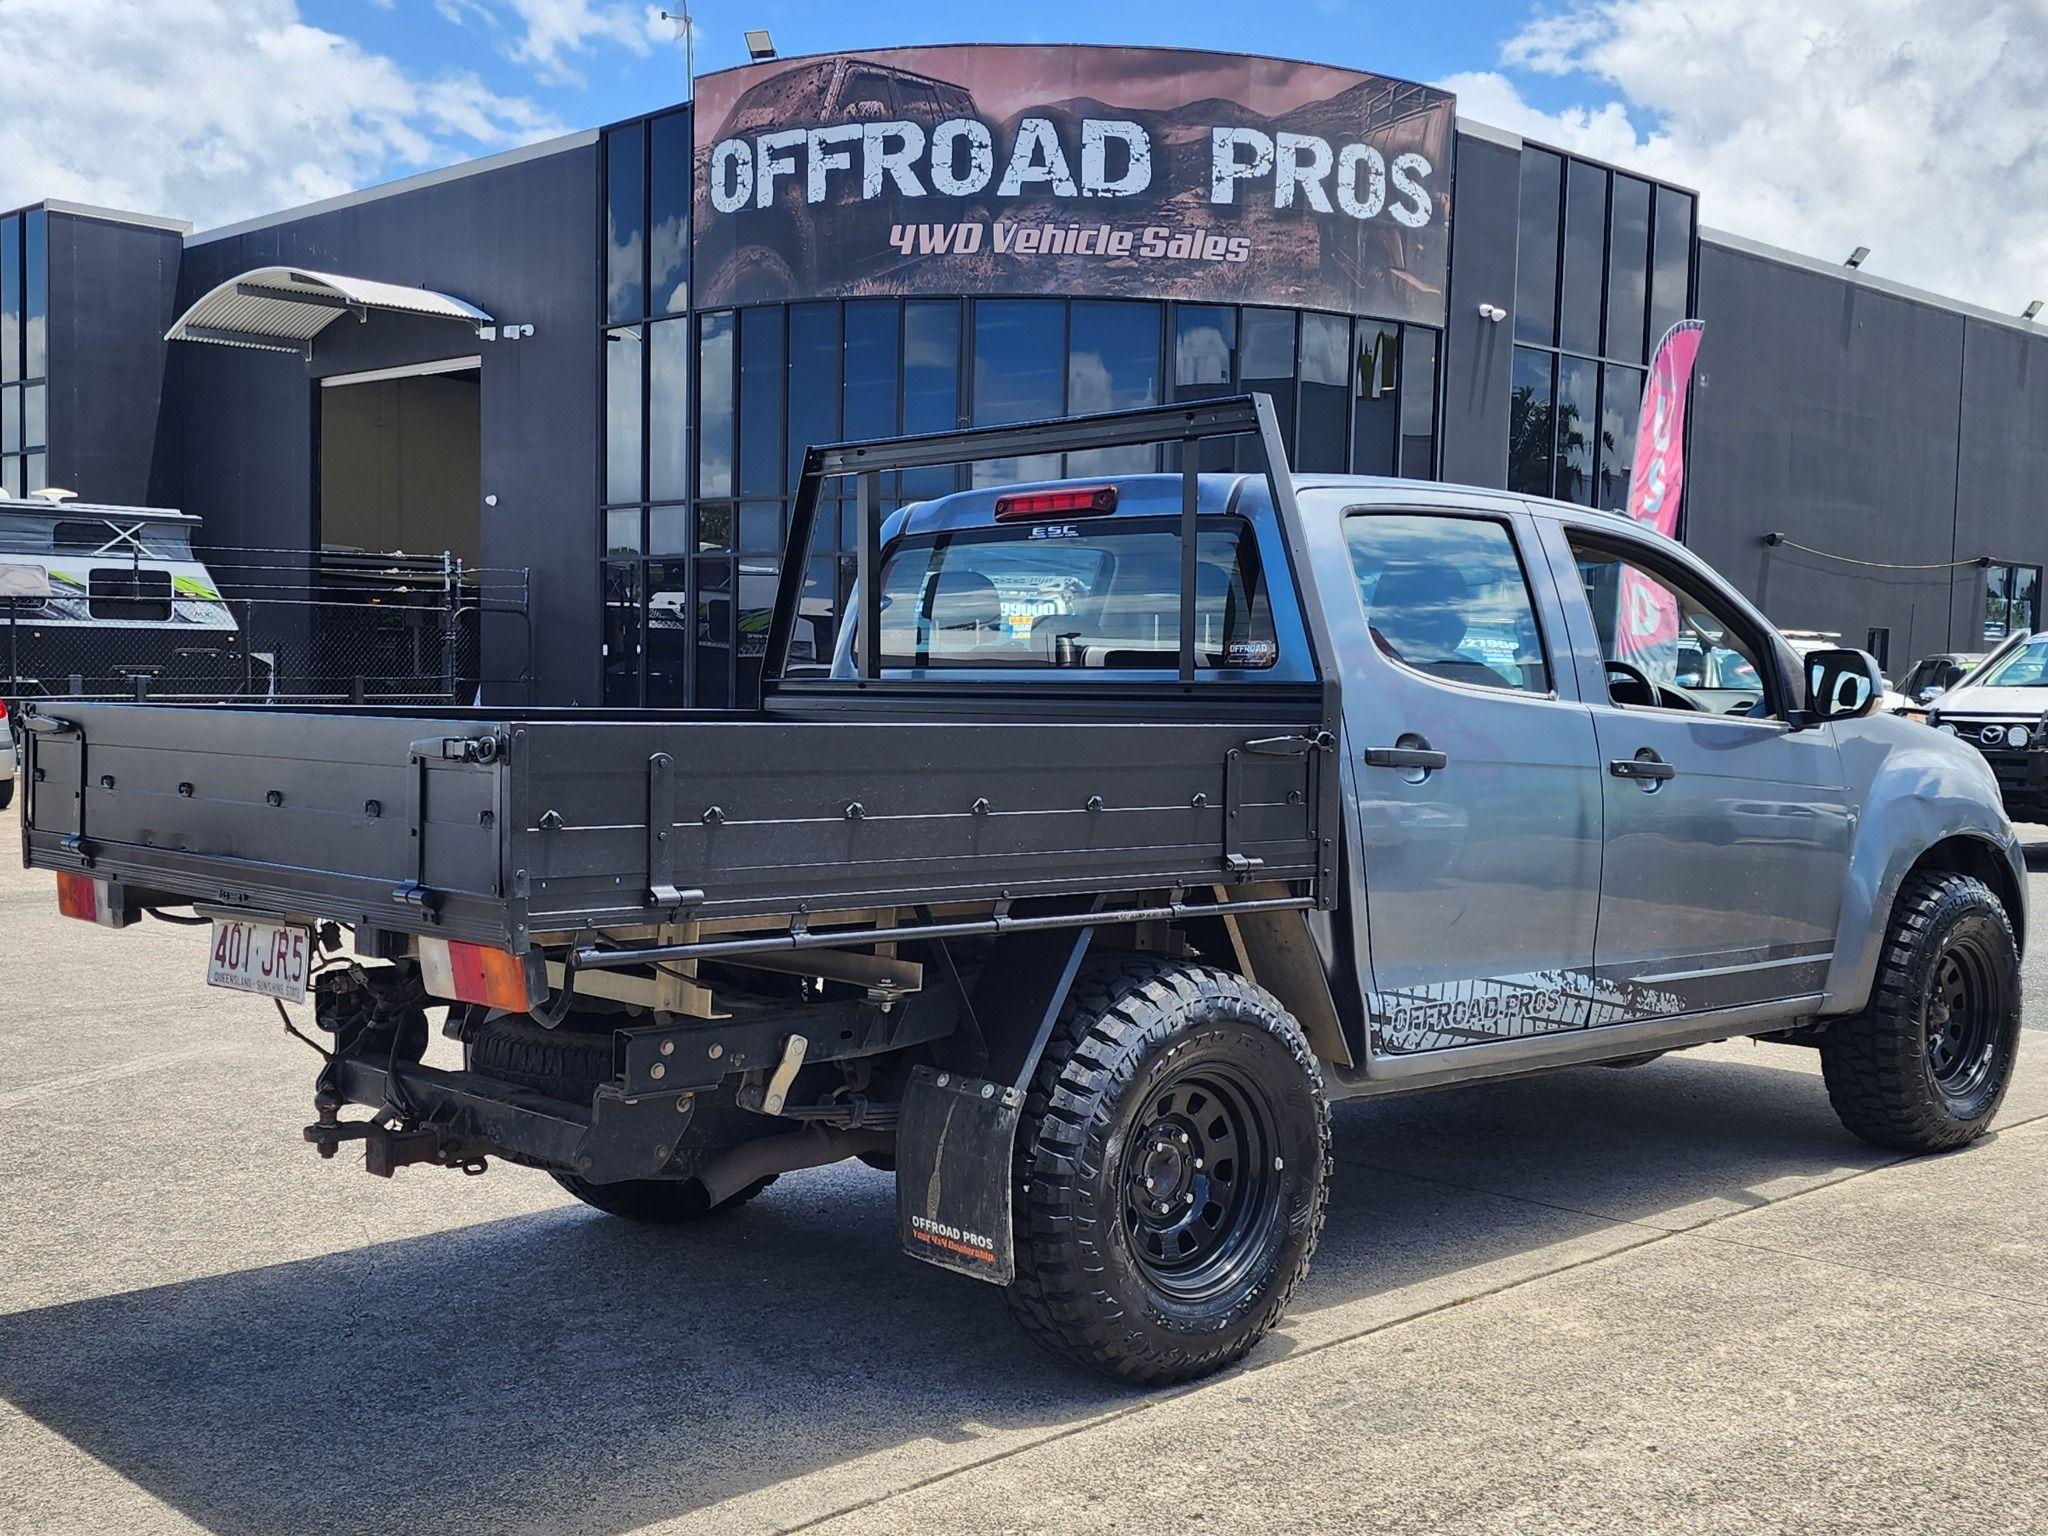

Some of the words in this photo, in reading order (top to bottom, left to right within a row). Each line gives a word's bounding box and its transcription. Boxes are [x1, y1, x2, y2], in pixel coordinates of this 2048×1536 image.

[710, 117, 1152, 214] OFFROAD
[1209, 125, 1433, 228] PROS
[889, 221, 982, 256] 4WD
[992, 221, 1136, 257] Vehicle
[1140, 225, 1251, 263] Sales
[1032, 525, 1078, 535] ESC
[1229, 644, 1267, 653] OFFROAD
[214, 923, 253, 973] 401
[261, 931, 304, 982] JR5
[214, 972, 252, 986] QUEENSLAND
[1391, 997, 1500, 1033] OFFROAD
[1503, 987, 1562, 1020] PROS
[912, 1216, 960, 1239] OFFROAD
[963, 1231, 994, 1249] PROS
[912, 1229, 930, 1241] Your
[948, 1241, 996, 1261] Dealership
